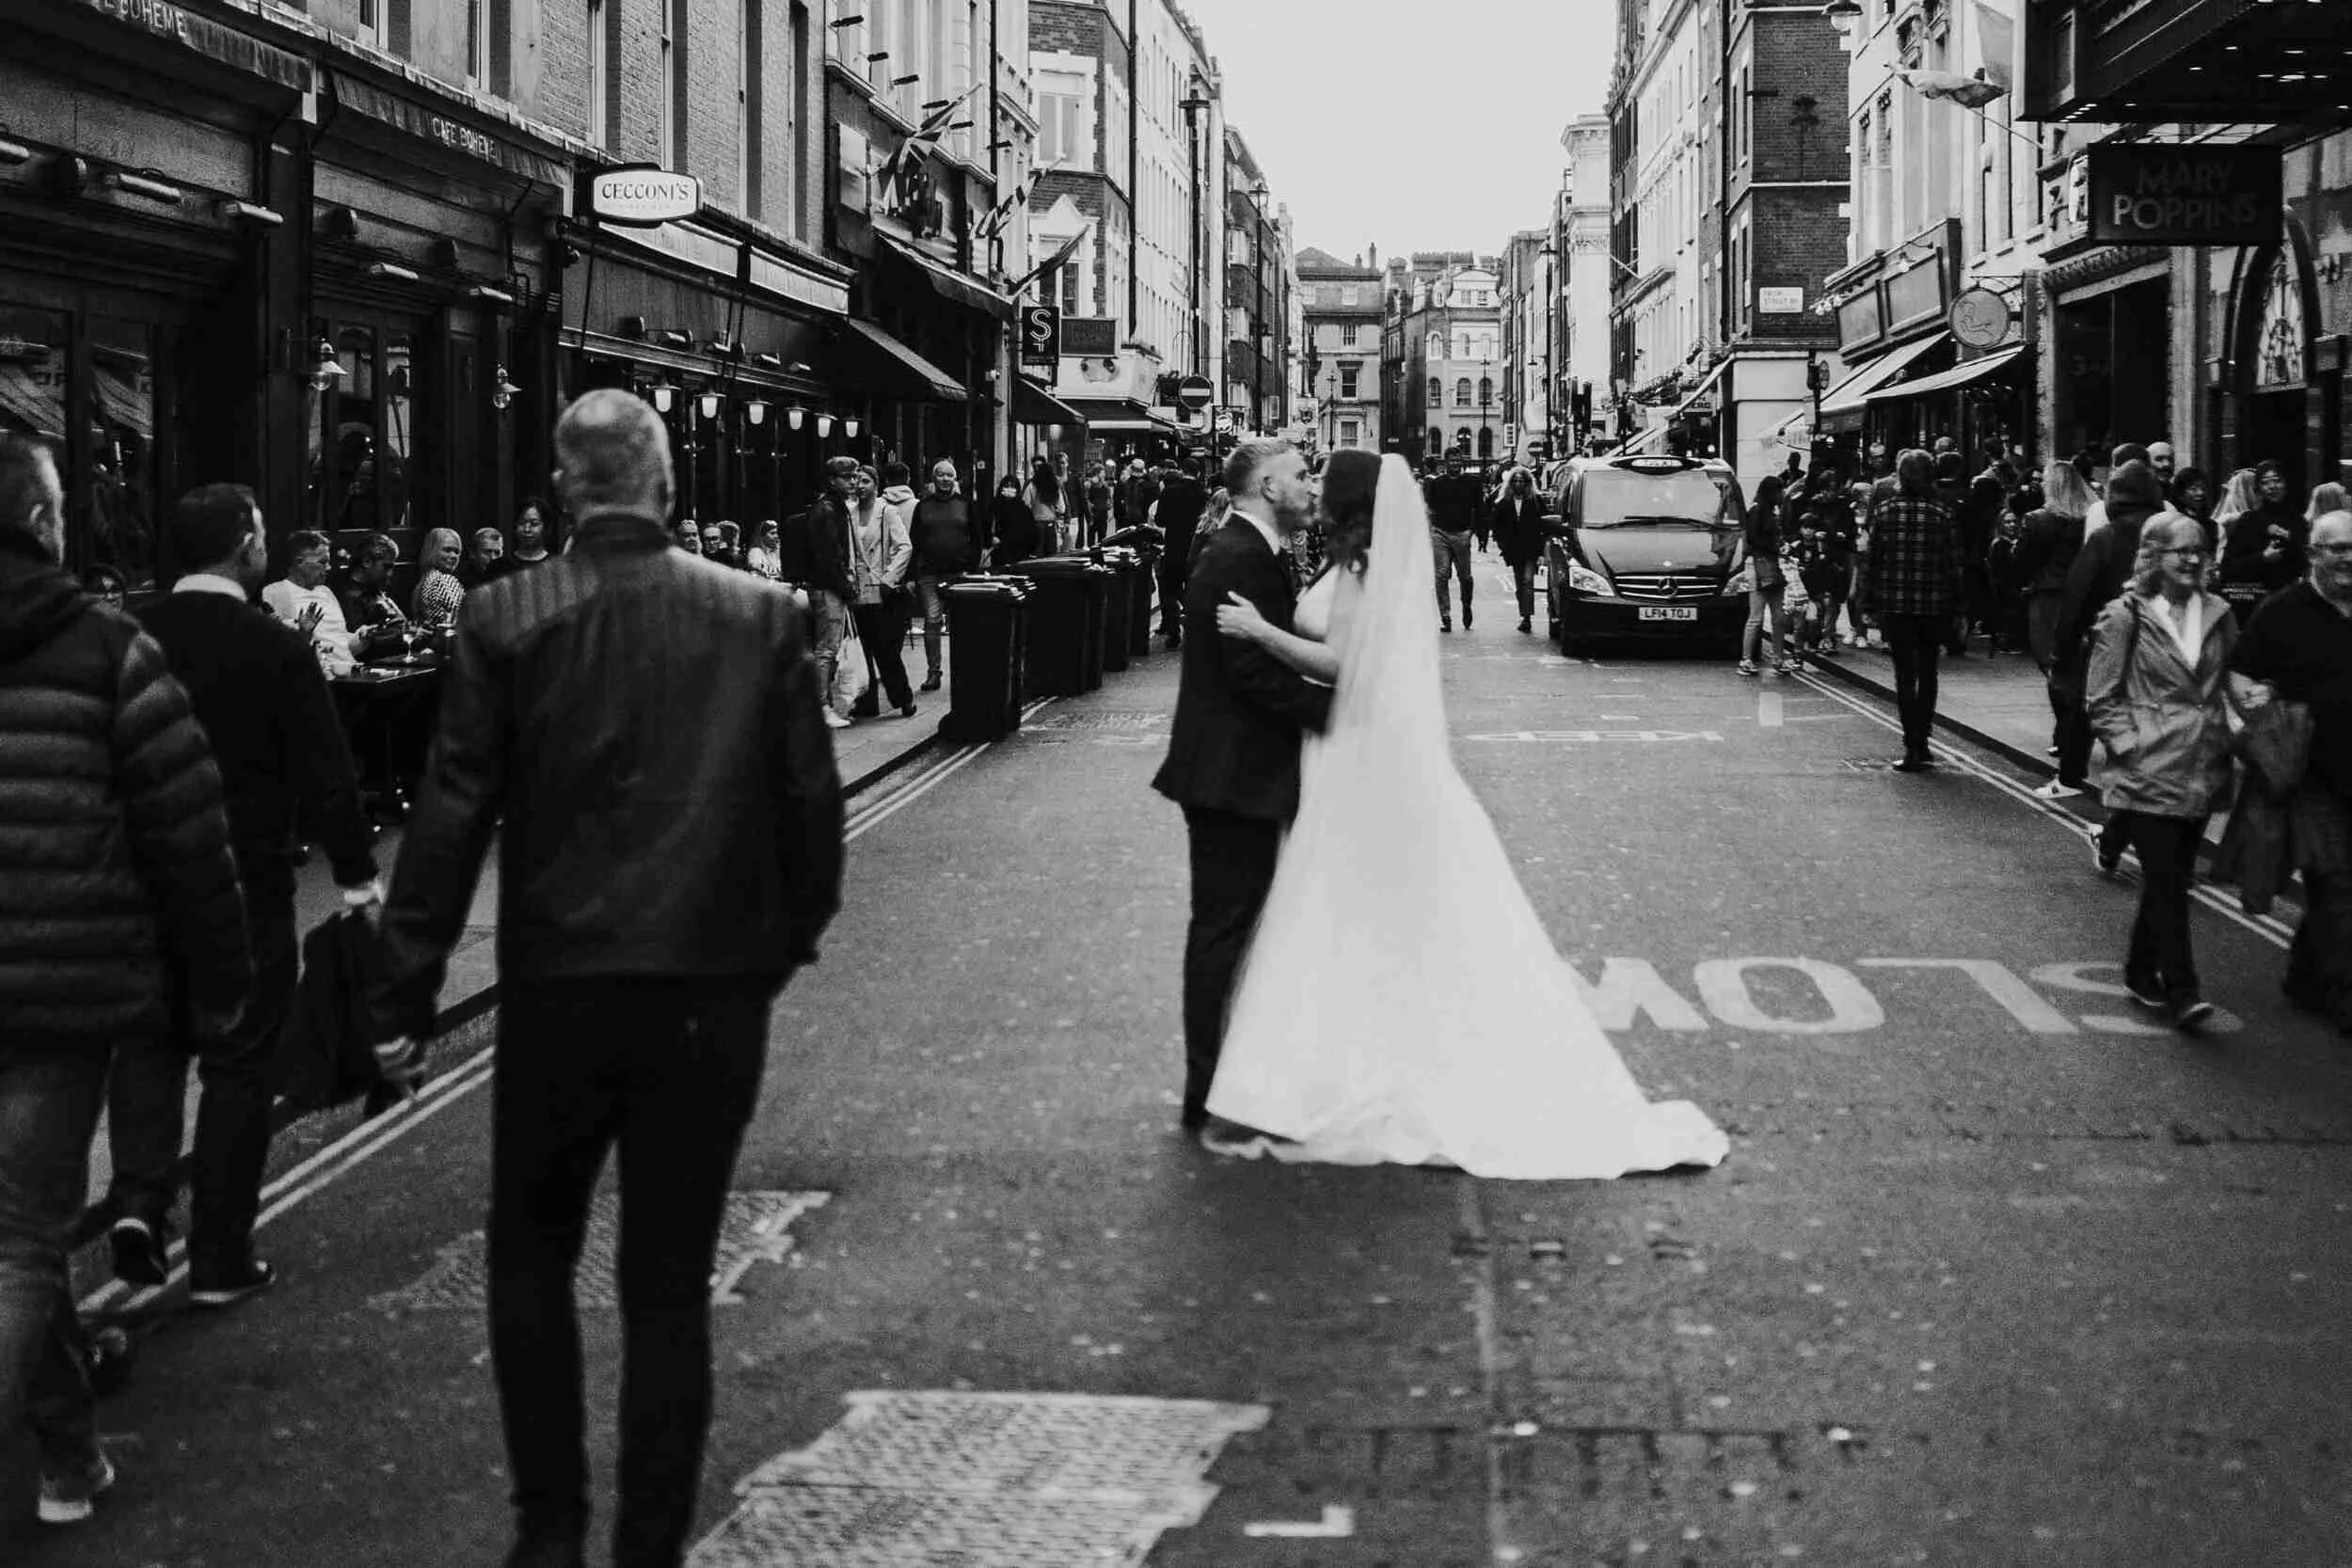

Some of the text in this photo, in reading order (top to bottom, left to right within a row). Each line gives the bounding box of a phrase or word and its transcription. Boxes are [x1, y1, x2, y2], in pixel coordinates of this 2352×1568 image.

[602, 182, 690, 200] CECCONI'S
[2137, 160, 2235, 196] MARY
[2114, 191, 2257, 230] POPPINS
[1645, 609, 1691, 619] LF14 TOJ
